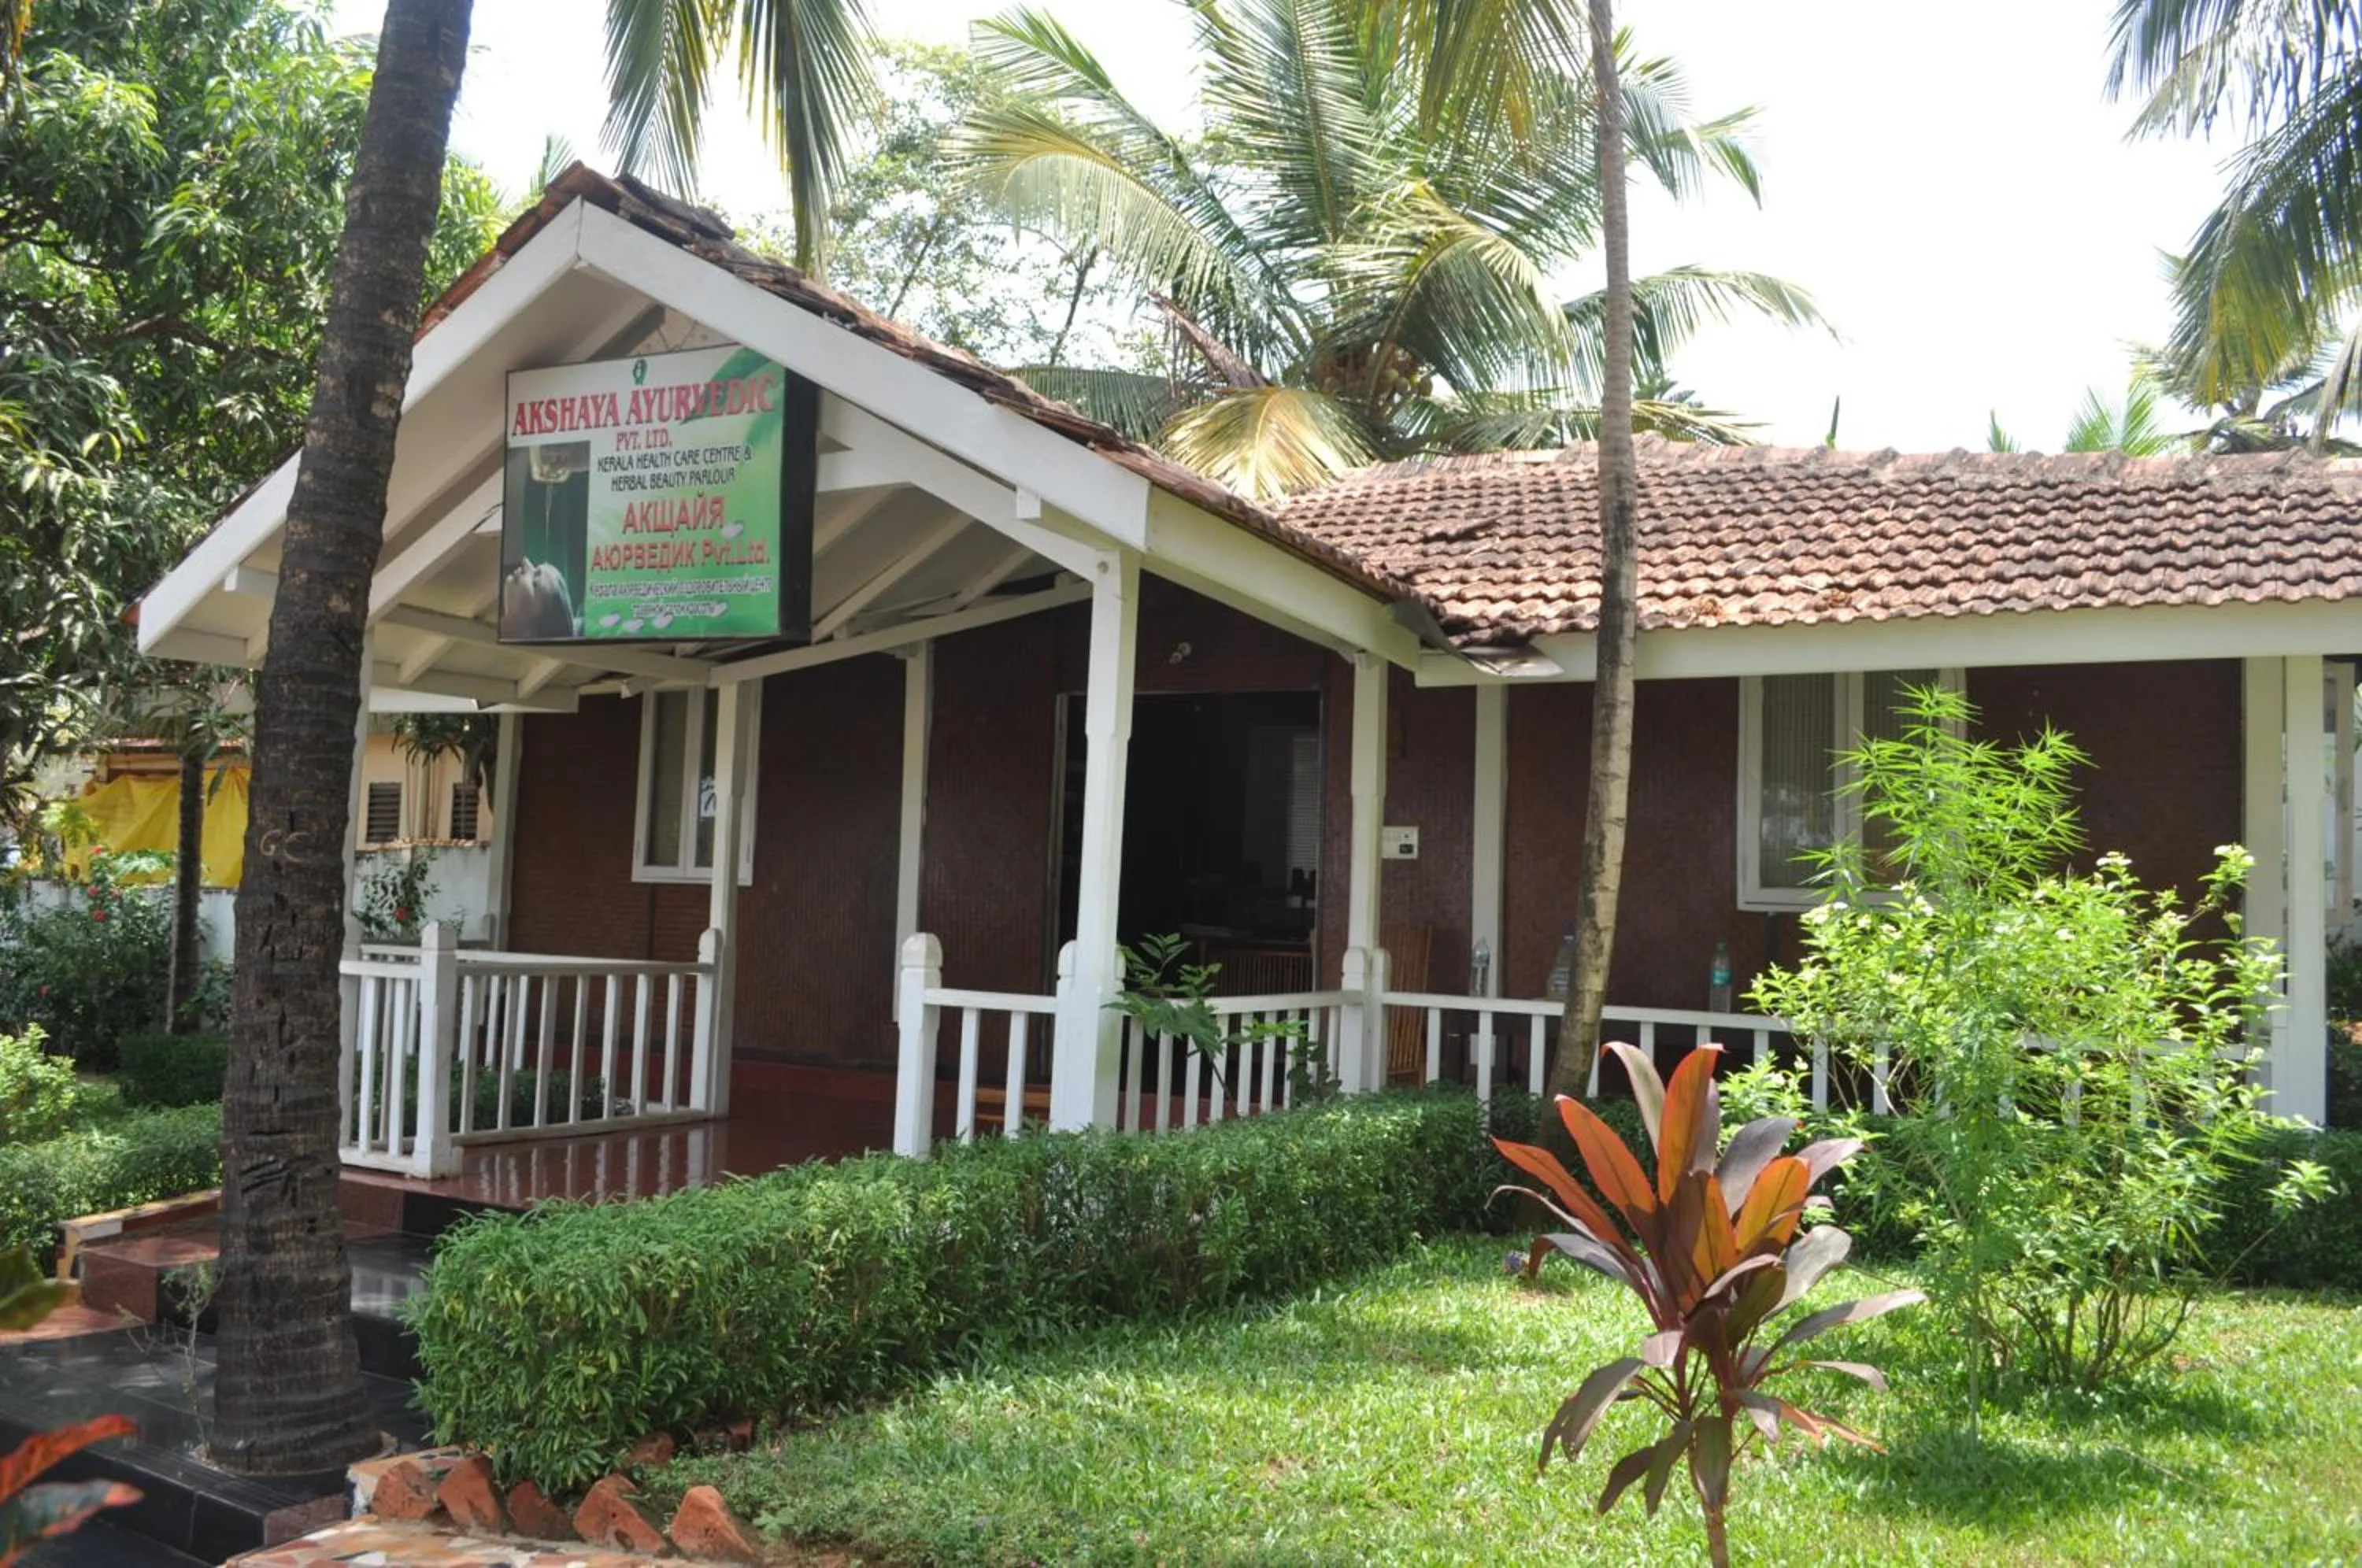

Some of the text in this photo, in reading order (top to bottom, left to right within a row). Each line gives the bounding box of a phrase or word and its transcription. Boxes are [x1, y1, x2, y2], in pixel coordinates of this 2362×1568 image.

[512, 373, 776, 436] AKSHAYA AYURVEDIC
[616, 429, 672, 451] PVT. LTD.
[598, 445, 752, 473] KERALA HEALTH CARE CENTRE &
[611, 468, 735, 492] HERBAL BEAUTY PARLOUR
